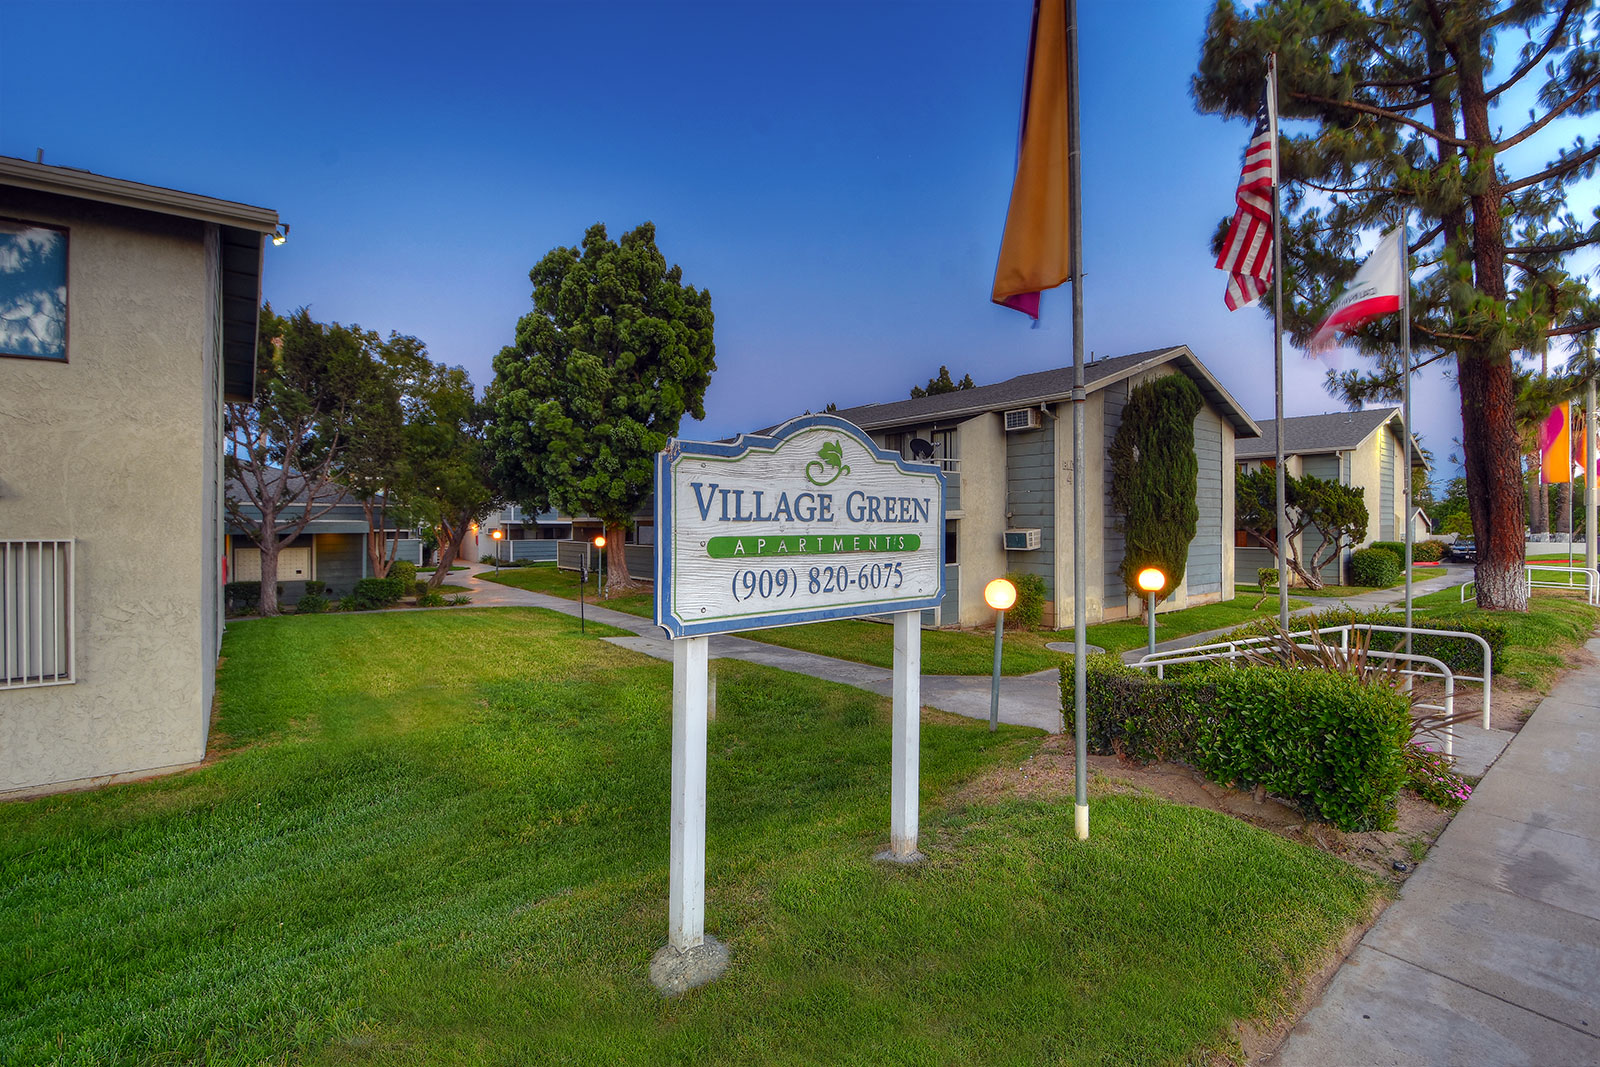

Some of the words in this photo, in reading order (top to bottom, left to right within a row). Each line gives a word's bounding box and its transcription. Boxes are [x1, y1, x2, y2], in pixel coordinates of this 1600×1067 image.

[690, 482, 834, 522] VILLAGE
[846, 490, 931, 523] GREEN
[733, 536, 905, 555] APARTMENTS
[732, 567, 798, 602] (909)
[808, 562, 904, 594] 820-6075
